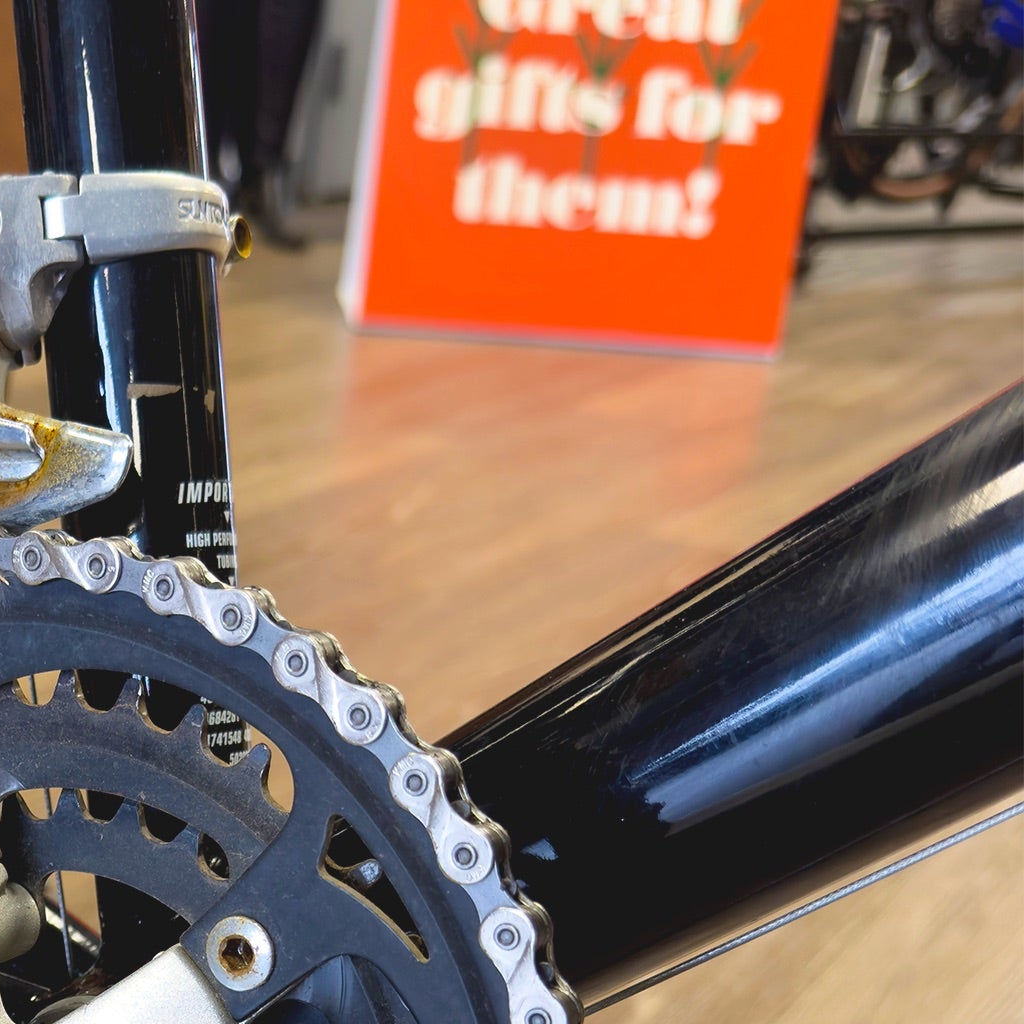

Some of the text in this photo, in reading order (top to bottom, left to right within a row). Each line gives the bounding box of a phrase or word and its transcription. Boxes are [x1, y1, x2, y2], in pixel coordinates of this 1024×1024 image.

[414, 53, 783, 146] gifts for
[453, 154, 722, 240] them!
[186, 533, 210, 548] HIGH
